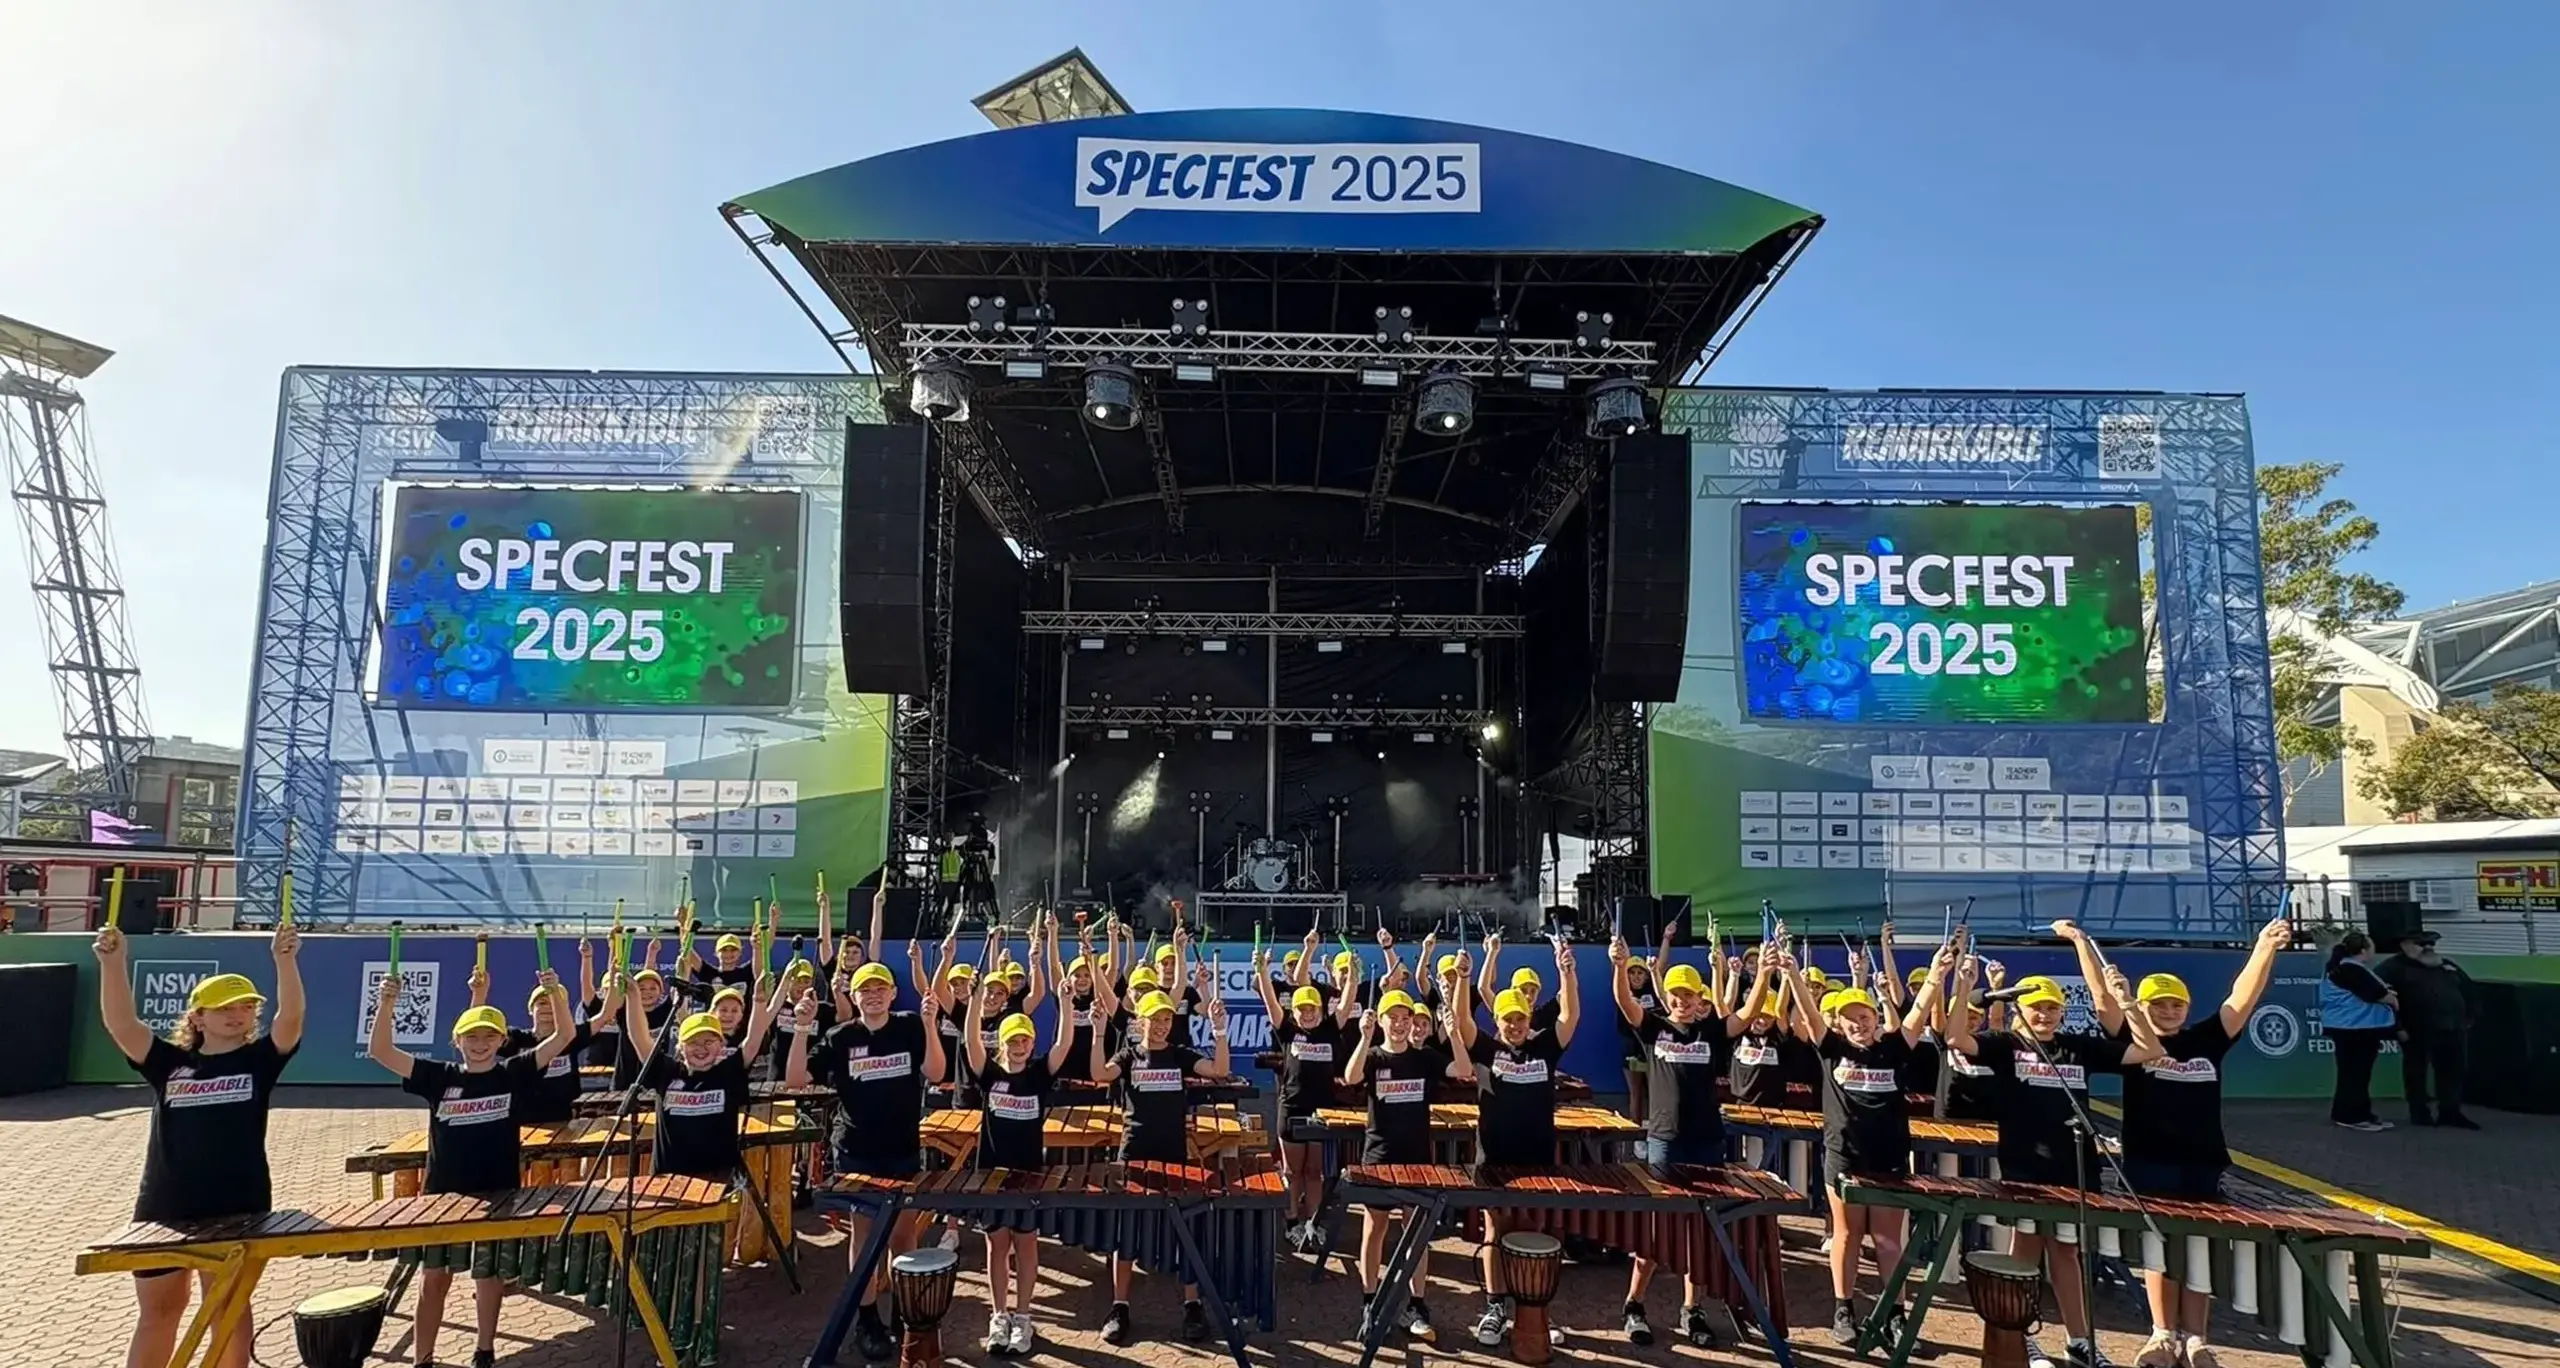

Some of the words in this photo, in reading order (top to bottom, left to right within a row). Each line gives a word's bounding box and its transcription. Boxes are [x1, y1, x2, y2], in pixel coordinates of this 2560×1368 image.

[1086, 148, 1316, 201] SPECFEST
[1331, 154, 1466, 202] 2025
[1729, 448, 1787, 468] NSW
[1842, 423, 2048, 462] REMARKABLE
[456, 538, 734, 593] SPECFEST
[1804, 553, 2074, 607] SPECFEST
[513, 607, 665, 662] 2025
[1870, 622, 2017, 675] 2025
[143, 999, 188, 1014] PUBL
[145, 973, 206, 994] NSW
